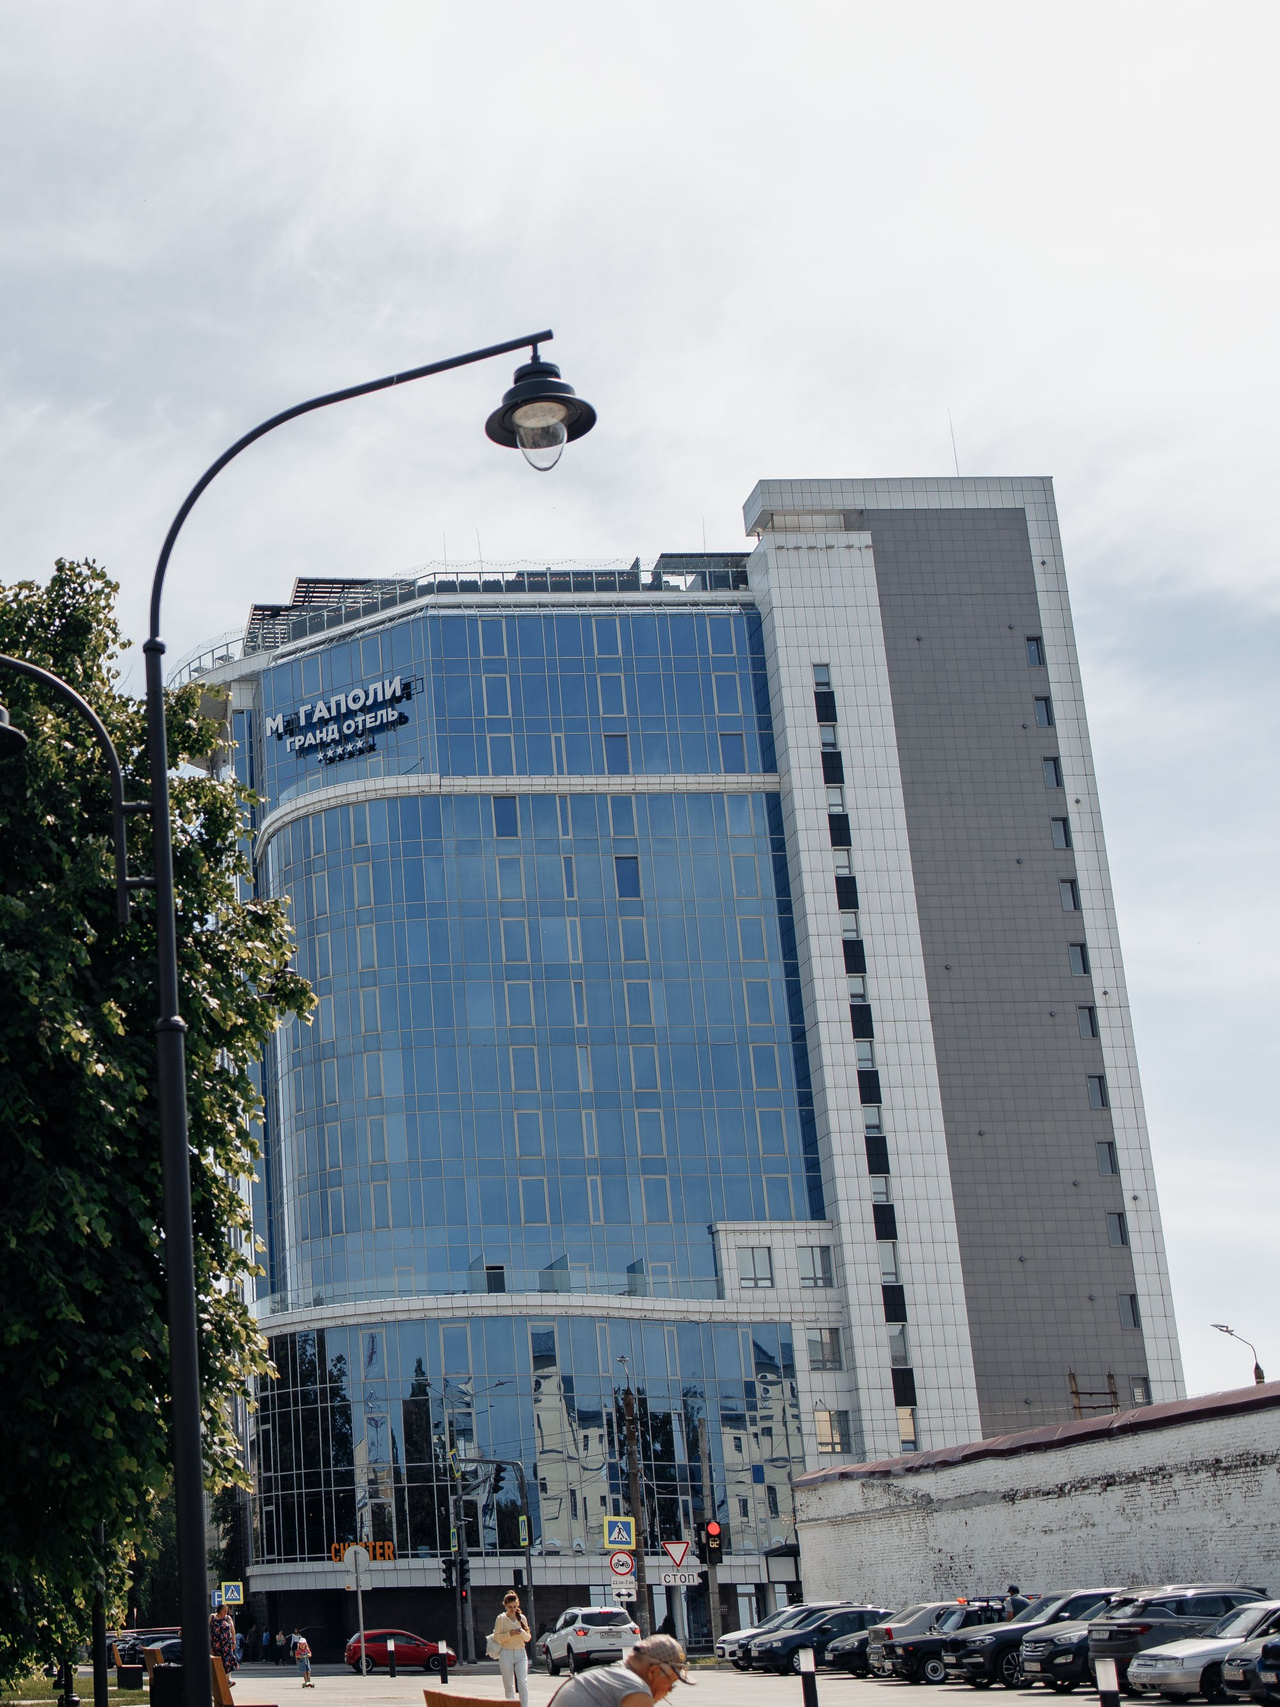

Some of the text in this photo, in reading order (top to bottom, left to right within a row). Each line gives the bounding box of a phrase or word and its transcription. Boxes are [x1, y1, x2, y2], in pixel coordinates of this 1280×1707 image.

[286, 707, 399, 752] ГРАНД ОТЕЛЬ
[710, 1538, 719, 1547] 62
[331, 1541, 394, 1562] CHTER
[664, 1574, 695, 1584] СТОП
